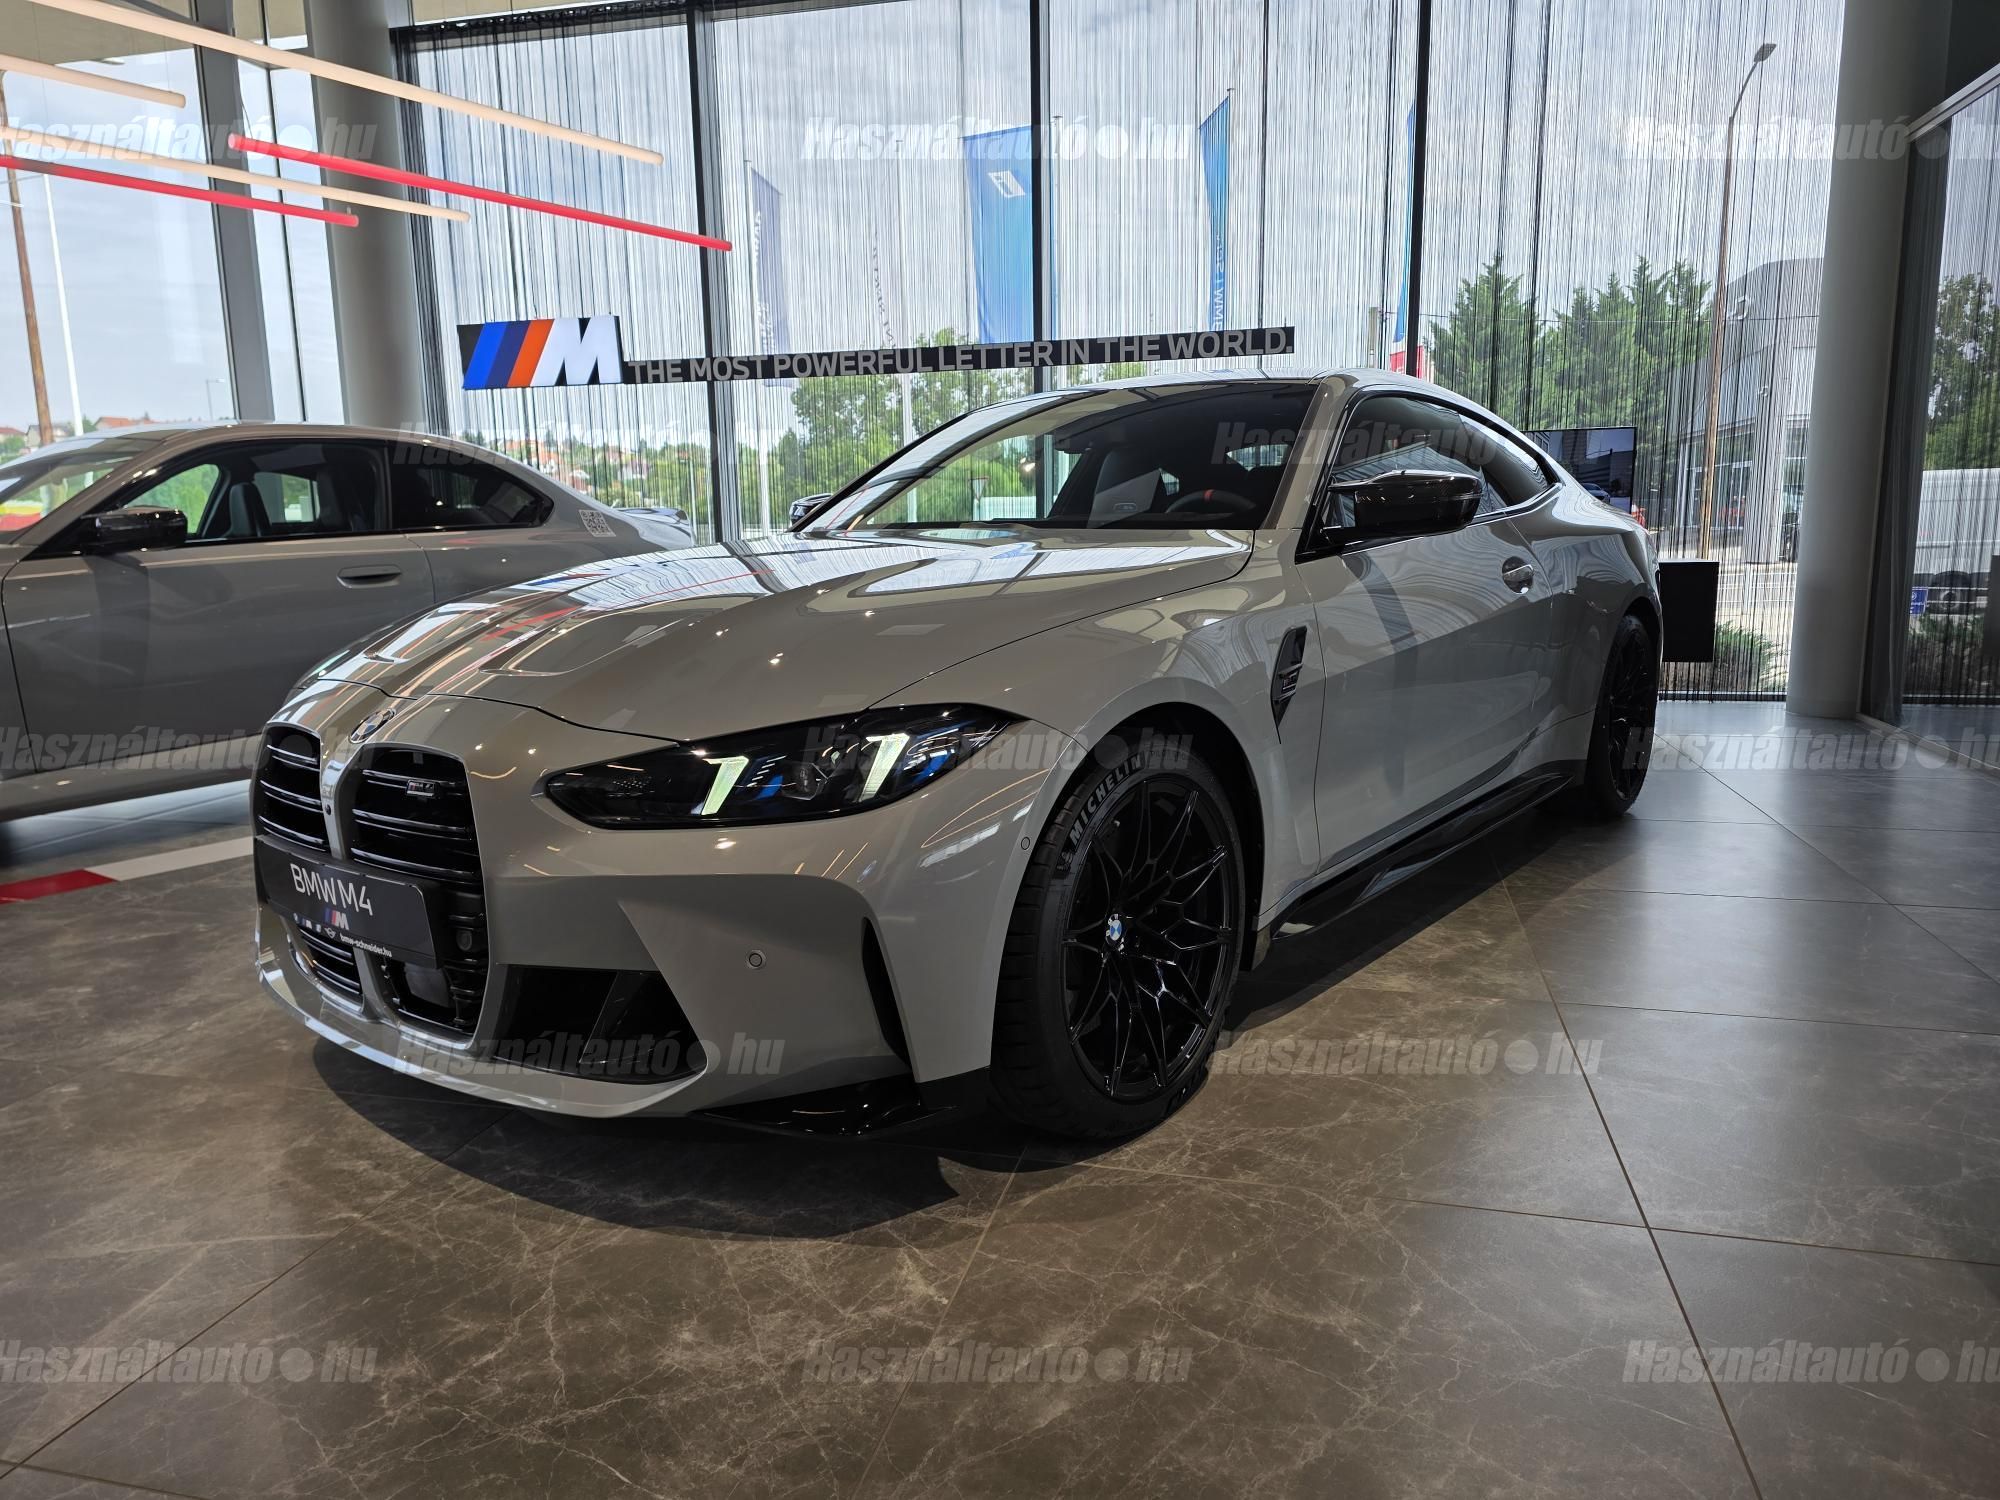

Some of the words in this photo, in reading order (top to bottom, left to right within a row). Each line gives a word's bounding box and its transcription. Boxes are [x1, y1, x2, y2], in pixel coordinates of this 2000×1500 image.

[530, 315, 621, 386] M
[628, 359, 682, 384] THE
[689, 354, 768, 382] MOST
[774, 349, 934, 379] POWERFUL
[938, 341, 1054, 371] LETTER
[1060, 338, 1090, 366] IN
[1097, 334, 1161, 364] THE
[1167, 327, 1294, 359] WORLD.
[1068, 752, 1145, 847] MICHELIN
[290, 863, 337, 905] BMW
[337, 879, 374, 917] M4
